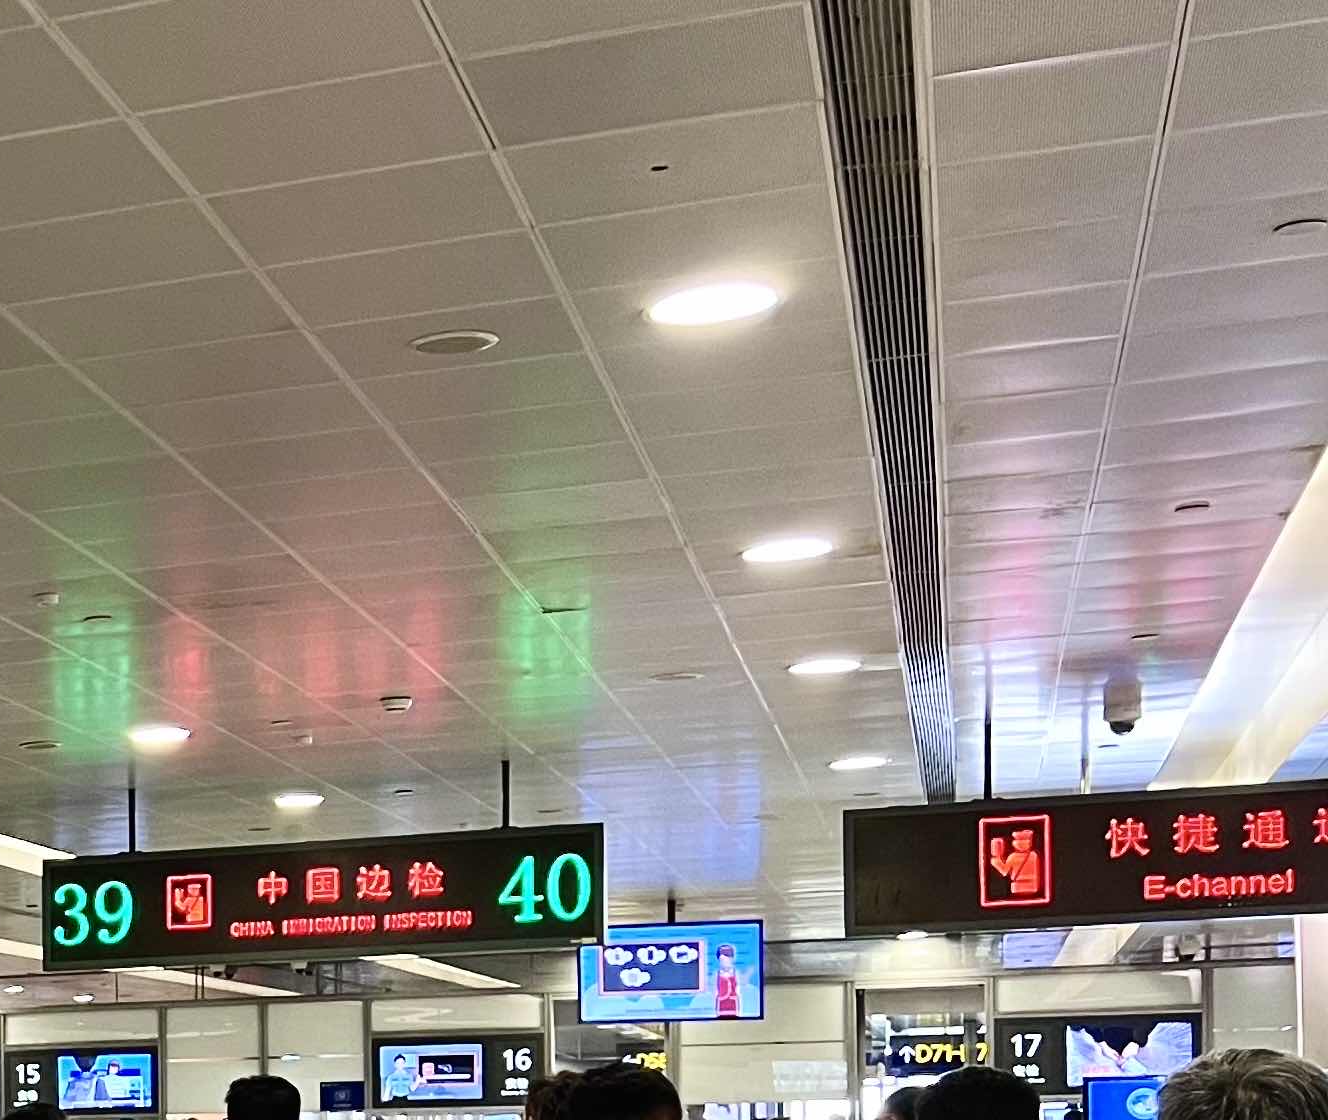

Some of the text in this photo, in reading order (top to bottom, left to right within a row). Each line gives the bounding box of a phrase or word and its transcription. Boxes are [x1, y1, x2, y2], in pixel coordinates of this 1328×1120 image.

[258, 862, 443, 904] 中国边检
[498, 853, 591, 923] 40
[1144, 869, 1294, 899] E-channel
[54, 881, 132, 946] 39
[503, 1048, 532, 1071] 16
[1011, 1034, 1042, 1057] 17
[16, 1064, 40, 1084] 15
